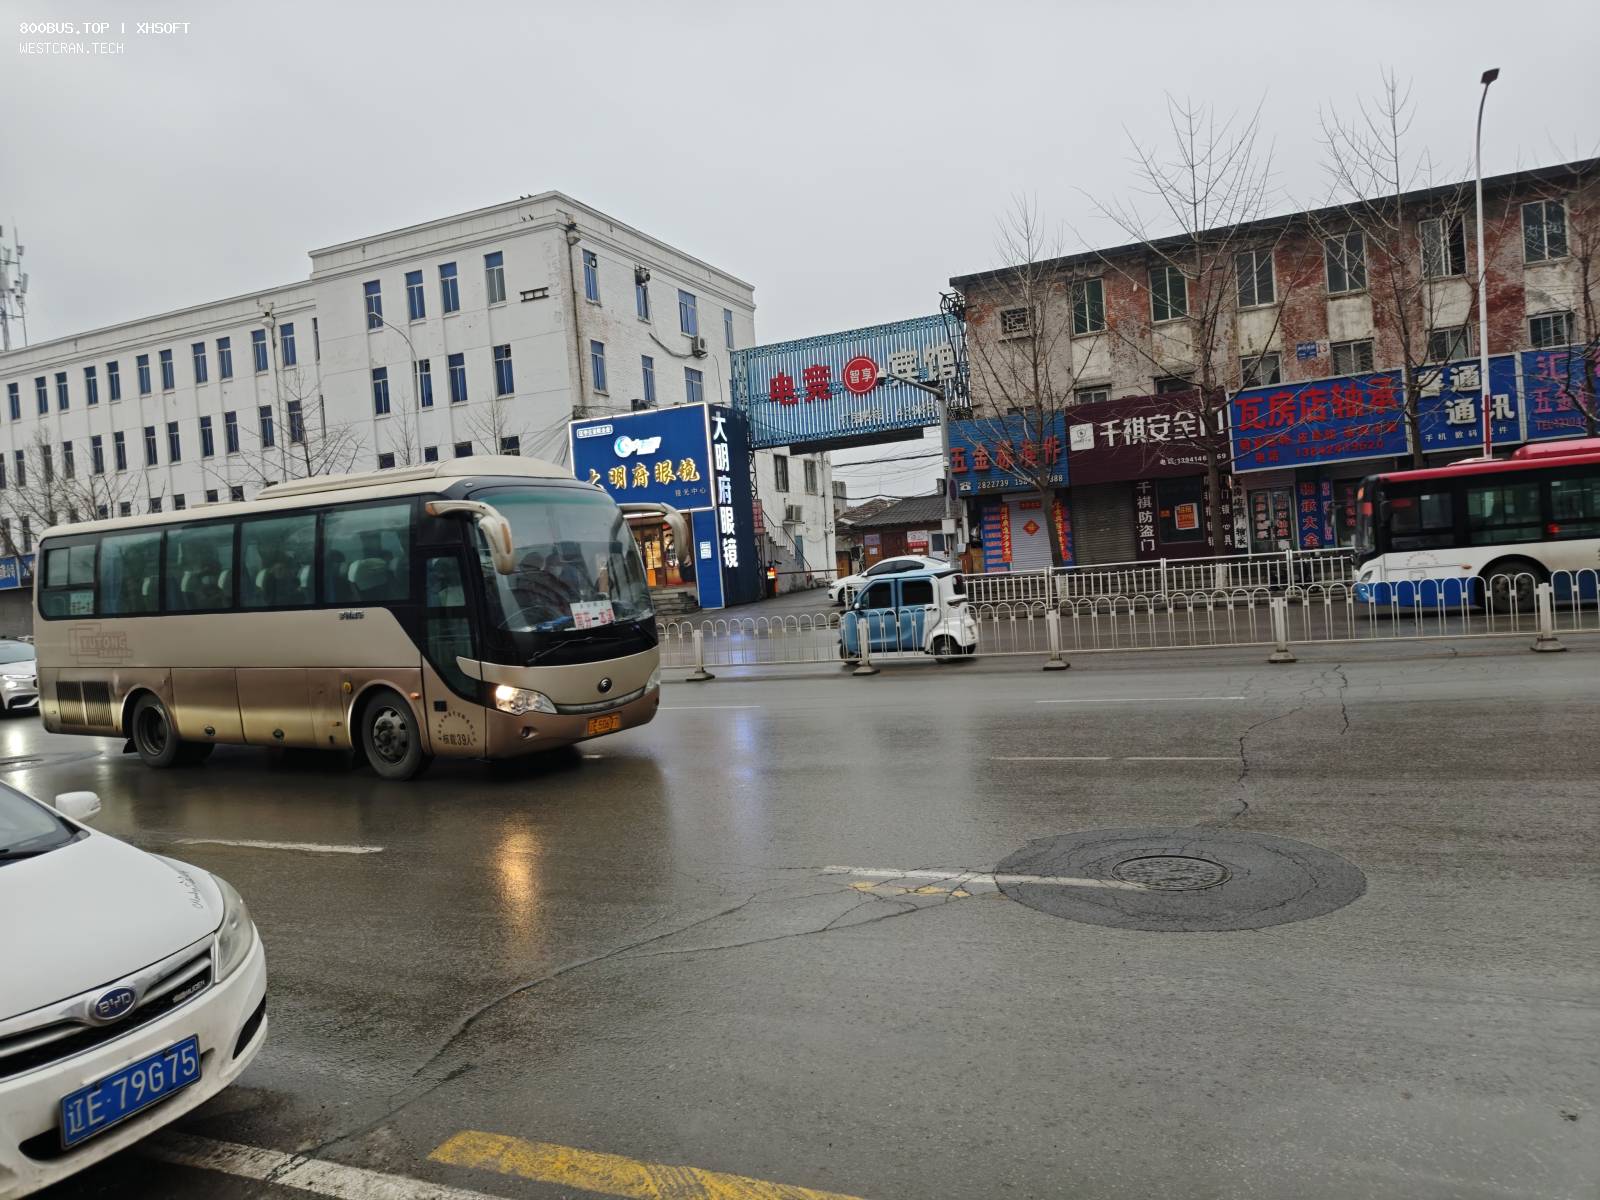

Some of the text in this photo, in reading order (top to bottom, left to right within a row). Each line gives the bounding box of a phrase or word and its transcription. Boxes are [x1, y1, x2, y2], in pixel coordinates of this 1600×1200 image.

[769, 363, 833, 406] 电竞
[849, 367, 872, 384] 智享
[1234, 377, 1398, 432] 瓦房店轴承
[1100, 406, 1225, 447] 千祺安全门
[1425, 433, 1447, 442] 手机
[711, 411, 738, 568] 大明府眼镜
[1136, 481, 1156, 552] 千祺防盗门
[98, 991, 133, 1014] BYD
